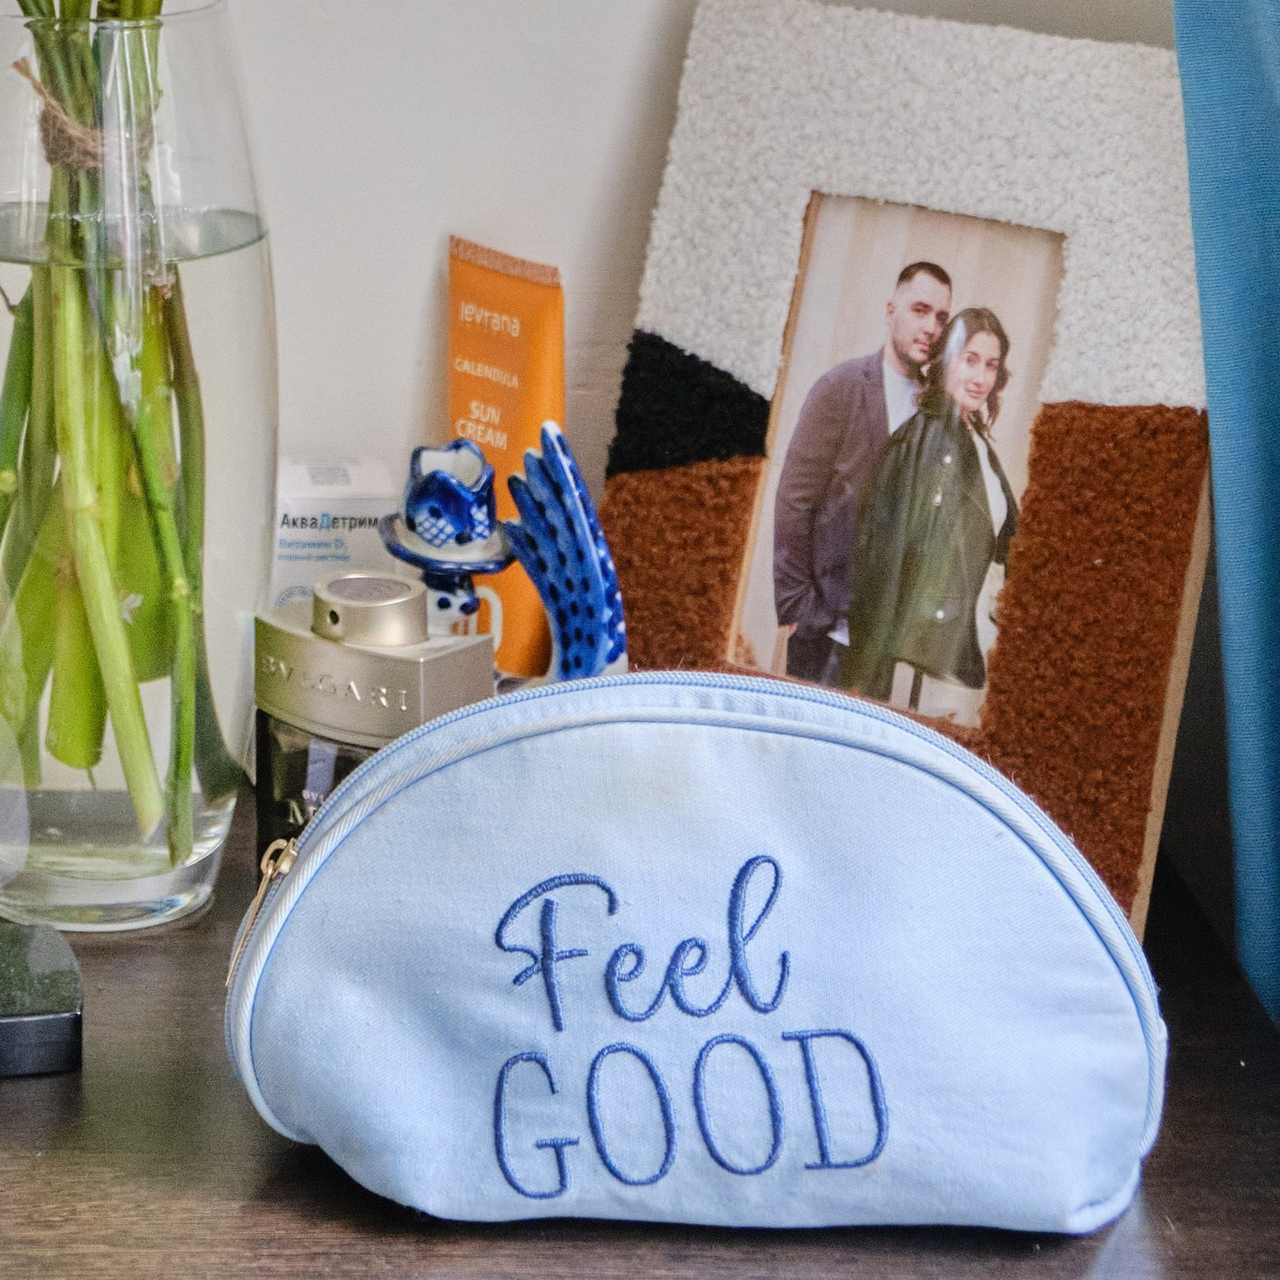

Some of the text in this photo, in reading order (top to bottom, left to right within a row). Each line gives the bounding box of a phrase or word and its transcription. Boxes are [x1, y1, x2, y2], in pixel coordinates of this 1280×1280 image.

[455, 356, 519, 389] CALENDULA
[470, 400, 501, 426] SUN
[454, 418, 508, 451] CREAM
[280, 513, 380, 533] АкваДетрим
[496, 855, 790, 1031] Feel
[493, 1028, 890, 1200] GOOD
